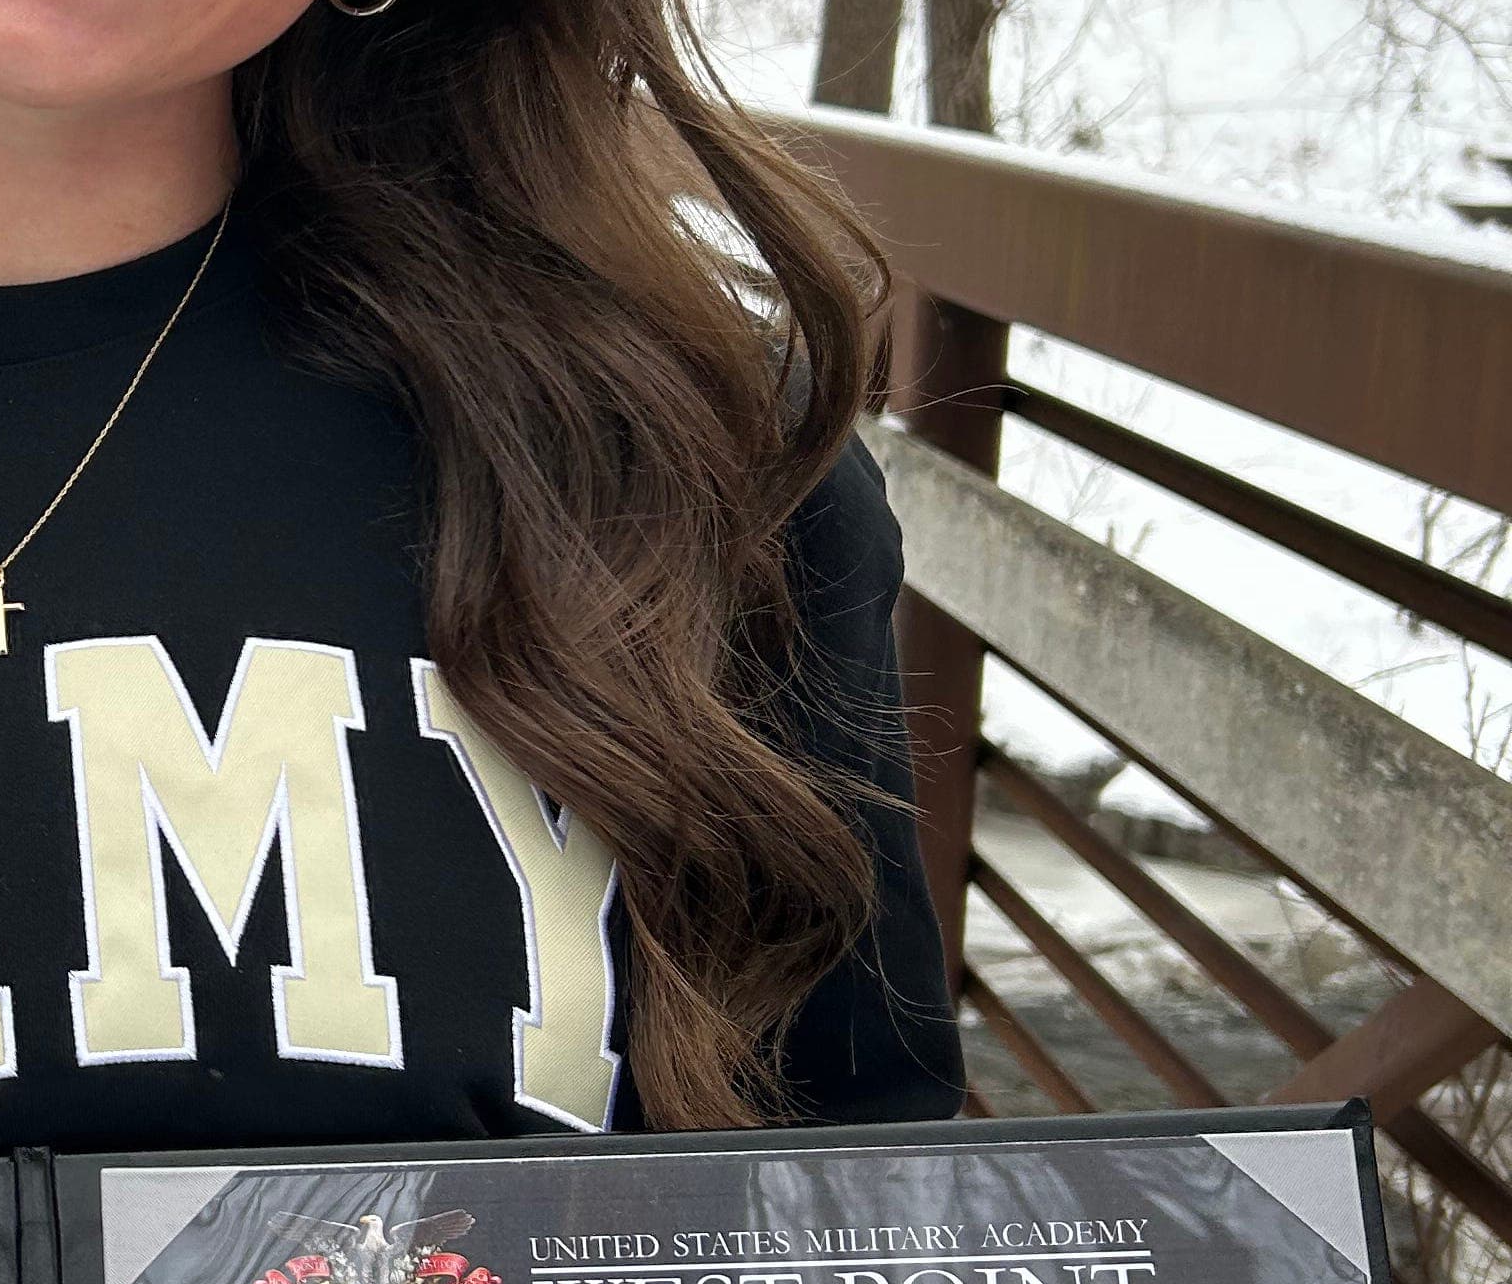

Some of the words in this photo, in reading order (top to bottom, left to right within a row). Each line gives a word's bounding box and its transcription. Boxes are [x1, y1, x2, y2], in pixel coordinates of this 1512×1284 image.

[529, 1234, 660, 1262] UNITED
[672, 1230, 791, 1258] STATES
[805, 1224, 965, 1254] MILITARY
[980, 1218, 1150, 1249] ACADEMY
